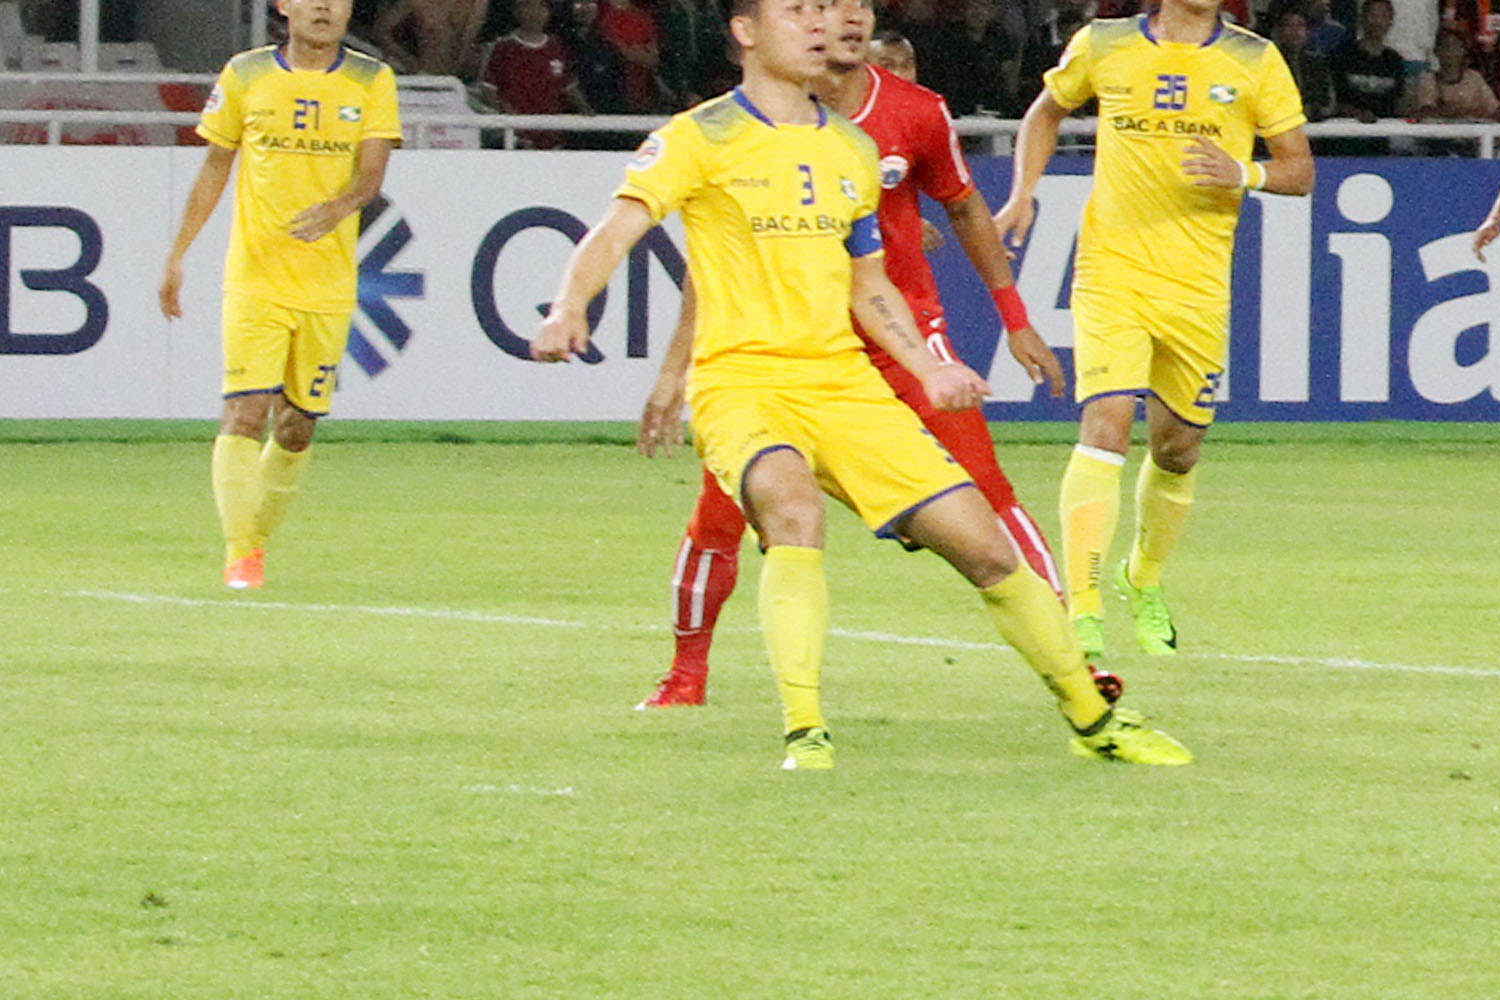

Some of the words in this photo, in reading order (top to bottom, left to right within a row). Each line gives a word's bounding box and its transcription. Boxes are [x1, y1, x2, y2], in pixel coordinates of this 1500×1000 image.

[1154, 74, 1188, 110] 26
[293, 98, 320, 130] 27
[1156, 119, 1168, 131] A
[1174, 120, 1222, 137] BANK
[798, 164, 816, 206] 3
[751, 215, 791, 232] BAC
[795, 216, 810, 231] A
